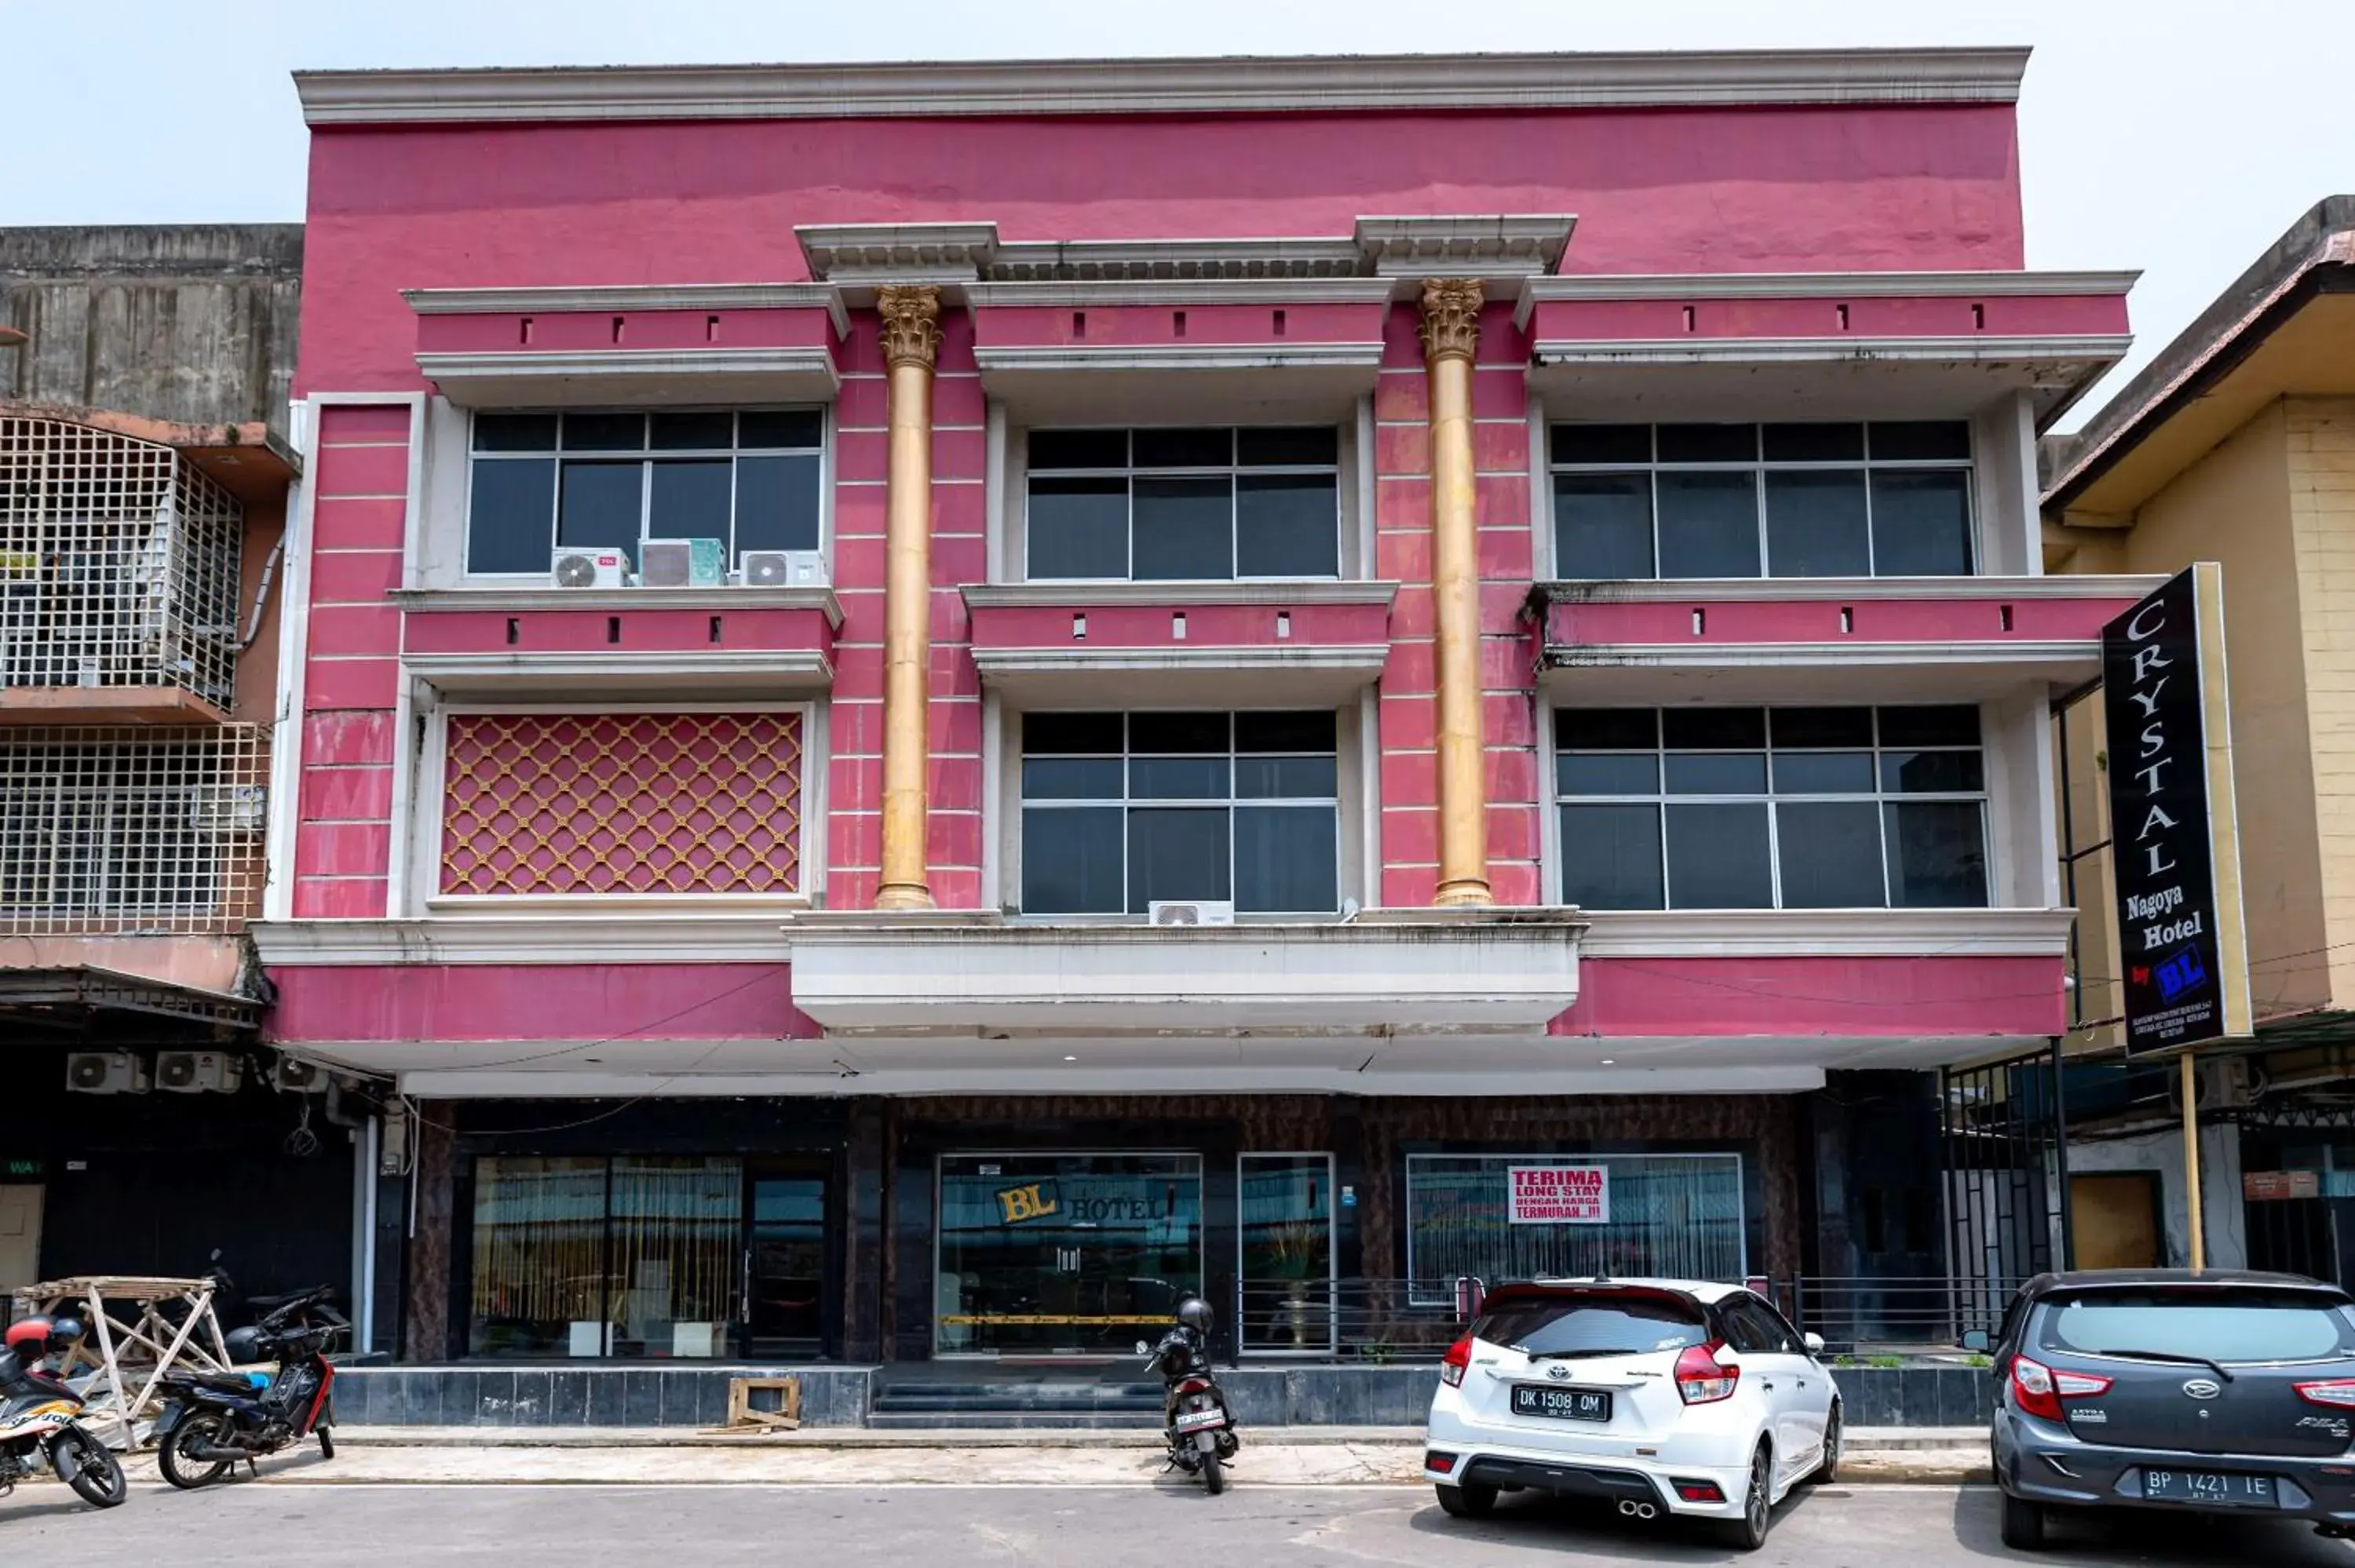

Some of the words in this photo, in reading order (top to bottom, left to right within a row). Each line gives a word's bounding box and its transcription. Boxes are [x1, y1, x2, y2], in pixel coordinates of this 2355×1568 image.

[2127, 599, 2179, 876] CRYSTAL
[2127, 885, 2183, 921] Nagoya
[2143, 911, 2203, 950] Hotel
[2159, 955, 2204, 997] BL
[1512, 1170, 1603, 1186] TERIMA
[1516, 1187, 1557, 1196] LONG
[1563, 1187, 1601, 1196] STAY
[999, 1183, 1056, 1223] BL
[1069, 1198, 1165, 1220] HOTEL
[1520, 1390, 1536, 1406] DK
[1541, 1391, 1572, 1409] 1508
[2149, 1471, 2171, 1488] BP
[2186, 1474, 2228, 1491] 1421
[2246, 1476, 2266, 1494] IE
